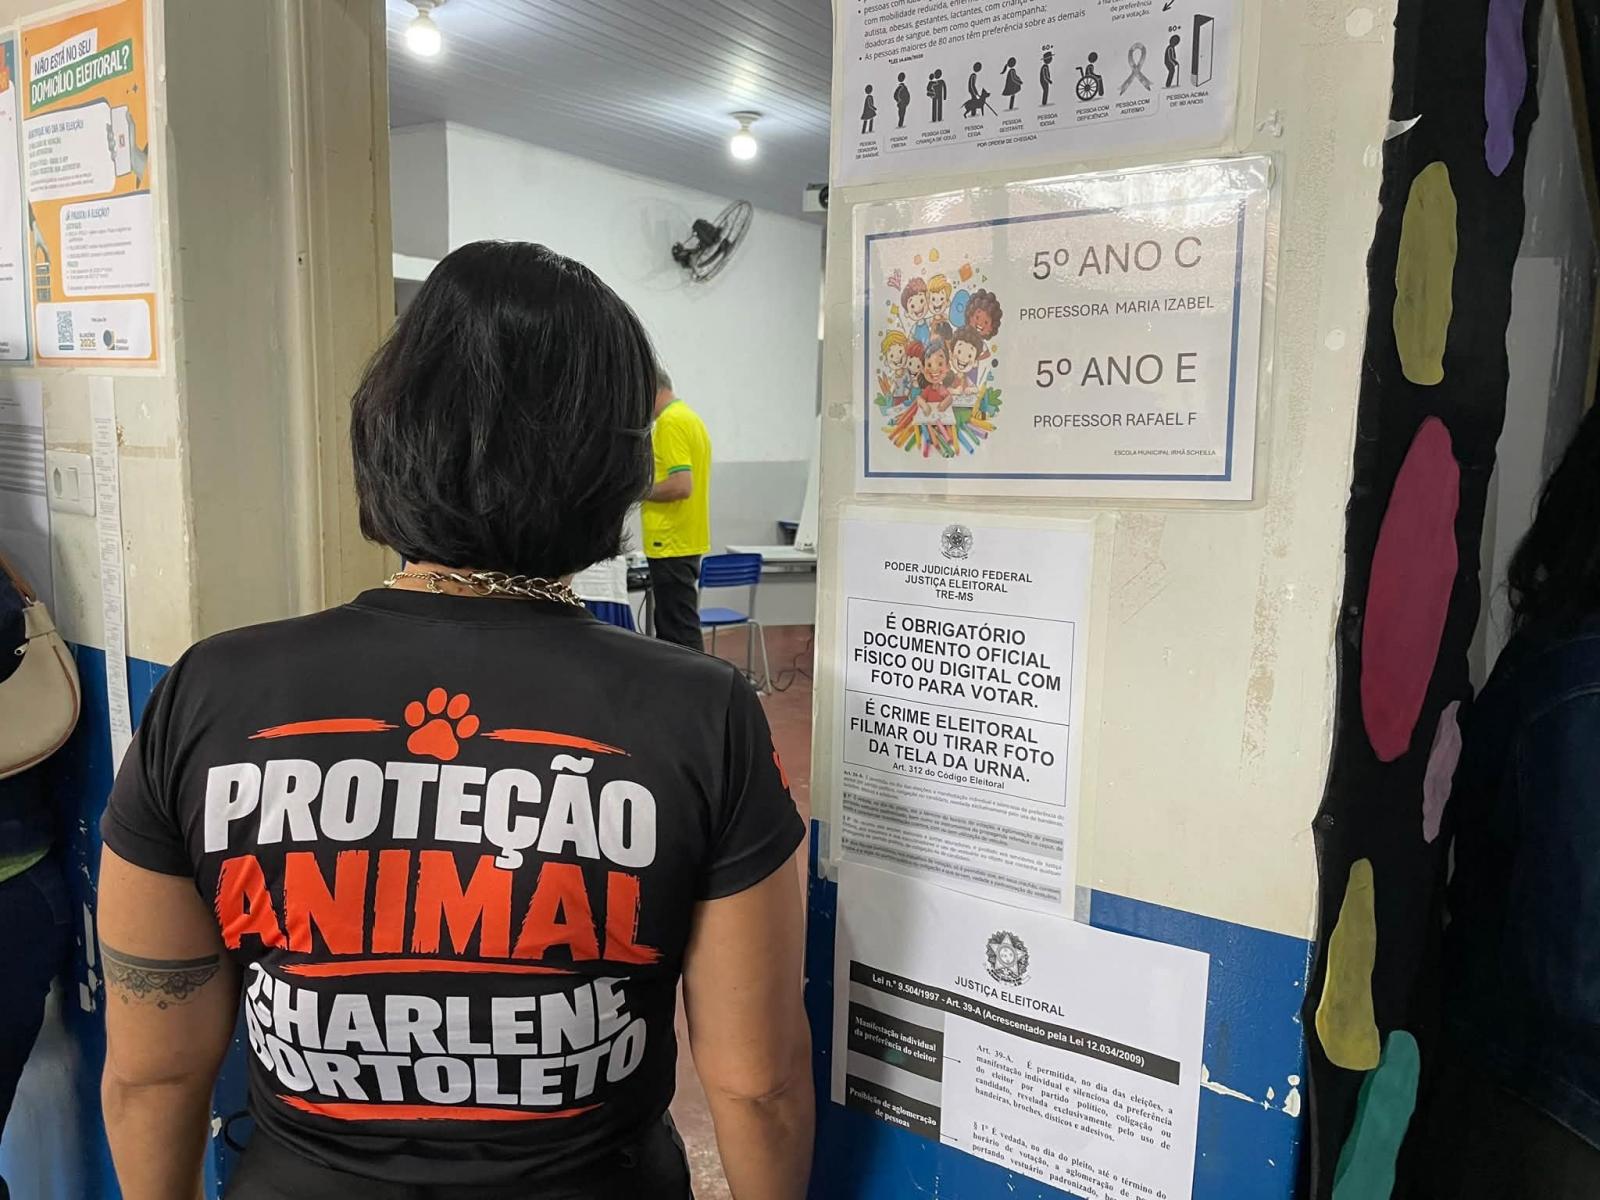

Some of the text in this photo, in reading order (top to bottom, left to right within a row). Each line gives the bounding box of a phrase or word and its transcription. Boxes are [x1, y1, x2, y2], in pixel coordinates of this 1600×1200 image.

[982, 22, 1022, 38] preferência
[1024, 18, 1046, 28] sobre
[1047, 16, 1056, 24] as
[1058, 8, 1086, 22] demais
[31, 45, 130, 105] DOMICÍLIO ELEITORAL?
[34, 38, 91, 76] NÃO ESTÁ NO SEU
[1078, 240, 1162, 276] ANO
[1174, 236, 1202, 268] C
[1020, 296, 1214, 320] PROFESSORA MARIA IZABEL
[1081, 354, 1163, 386] ANO
[1176, 352, 1197, 383] E
[1034, 412, 1197, 428] PROFESSOR RAFAEL F
[884, 561, 1032, 583] PODER JUDICIÁRIO FEDERAL
[905, 574, 1008, 593] JUSTIÇA ELEITORAL
[936, 589, 974, 602] TRE-MS
[886, 612, 1026, 645] É OBRIGATÓRIO
[854, 646, 1061, 691] FÍSICO OU DIGITAL COM
[864, 632, 1051, 669] DOCUMENTO OFICIAL
[872, 670, 1038, 708] FOTO PARA VOTAR.
[866, 698, 1038, 744] É CRIME ELEITORAL
[851, 718, 1054, 766] FILMAR OU TIRAR FOTO
[869, 739, 1030, 782] DA TELA DA URNA.
[893, 762, 1005, 789] Art. 312 do Código Eleitoral
[204, 754, 657, 869] PROTEÇÃO
[215, 849, 665, 964] ANIMAL
[245, 962, 631, 1055] CHARLENE
[954, 976, 1064, 1016] JUSTIÇA ELEITORAL
[856, 1016, 936, 1052] Manifestação individual
[872, 974, 884, 985] Lei
[898, 982, 940, 1001] 9.504/1997
[946, 998, 960, 1008] Art.
[962, 1002, 982, 1016] 39-A
[982, 1010, 1044, 1036] (Acrescentado
[1048, 1028, 1068, 1042] pela
[1070, 1035, 1084, 1046] Lei
[1087, 1040, 1144, 1067] 12.034/2009)
[245, 993, 647, 1106] BORTOLETO
[854, 1029, 937, 1064] da preferência do eleitor
[976, 1044, 990, 1054] Art.
[994, 1050, 1014, 1063] 39-A.
[1027, 1060, 1032, 1069] É
[1037, 1066, 1076, 1084] permitida,
[1096, 1082, 1108, 1092] dia
[1112, 1088, 1126, 1098] das
[976, 1056, 1022, 1076] manifestação
[1024, 1072, 1062, 1090] individual
[1073, 1087, 1110, 1104] silenciosa
[1114, 1100, 1122, 1109] da
[1126, 1106, 1172, 1126] preferência
[976, 1086, 1012, 1106] bandeiras,
[976, 1066, 1172, 1138] do eleitor por partido político, coligação ou
[875, 1108, 910, 1128] de pessoas
[882, 1100, 891, 1109] de
[892, 1105, 936, 1126] aglomeração
[976, 1077, 1170, 1150] candidato, revelada exclusivamente pelo uso de
[972, 1144, 1004, 1160] portando
[1030, 1144, 1040, 1152] no
[1043, 1148, 1054, 1158] dia
[1058, 1153, 1068, 1162] do
[1098, 1168, 1110, 1178] até
[1122, 1176, 1152, 1194] término
[1156, 1190, 1166, 1200] do
[1066, 1168, 1114, 1191] aglomeração
